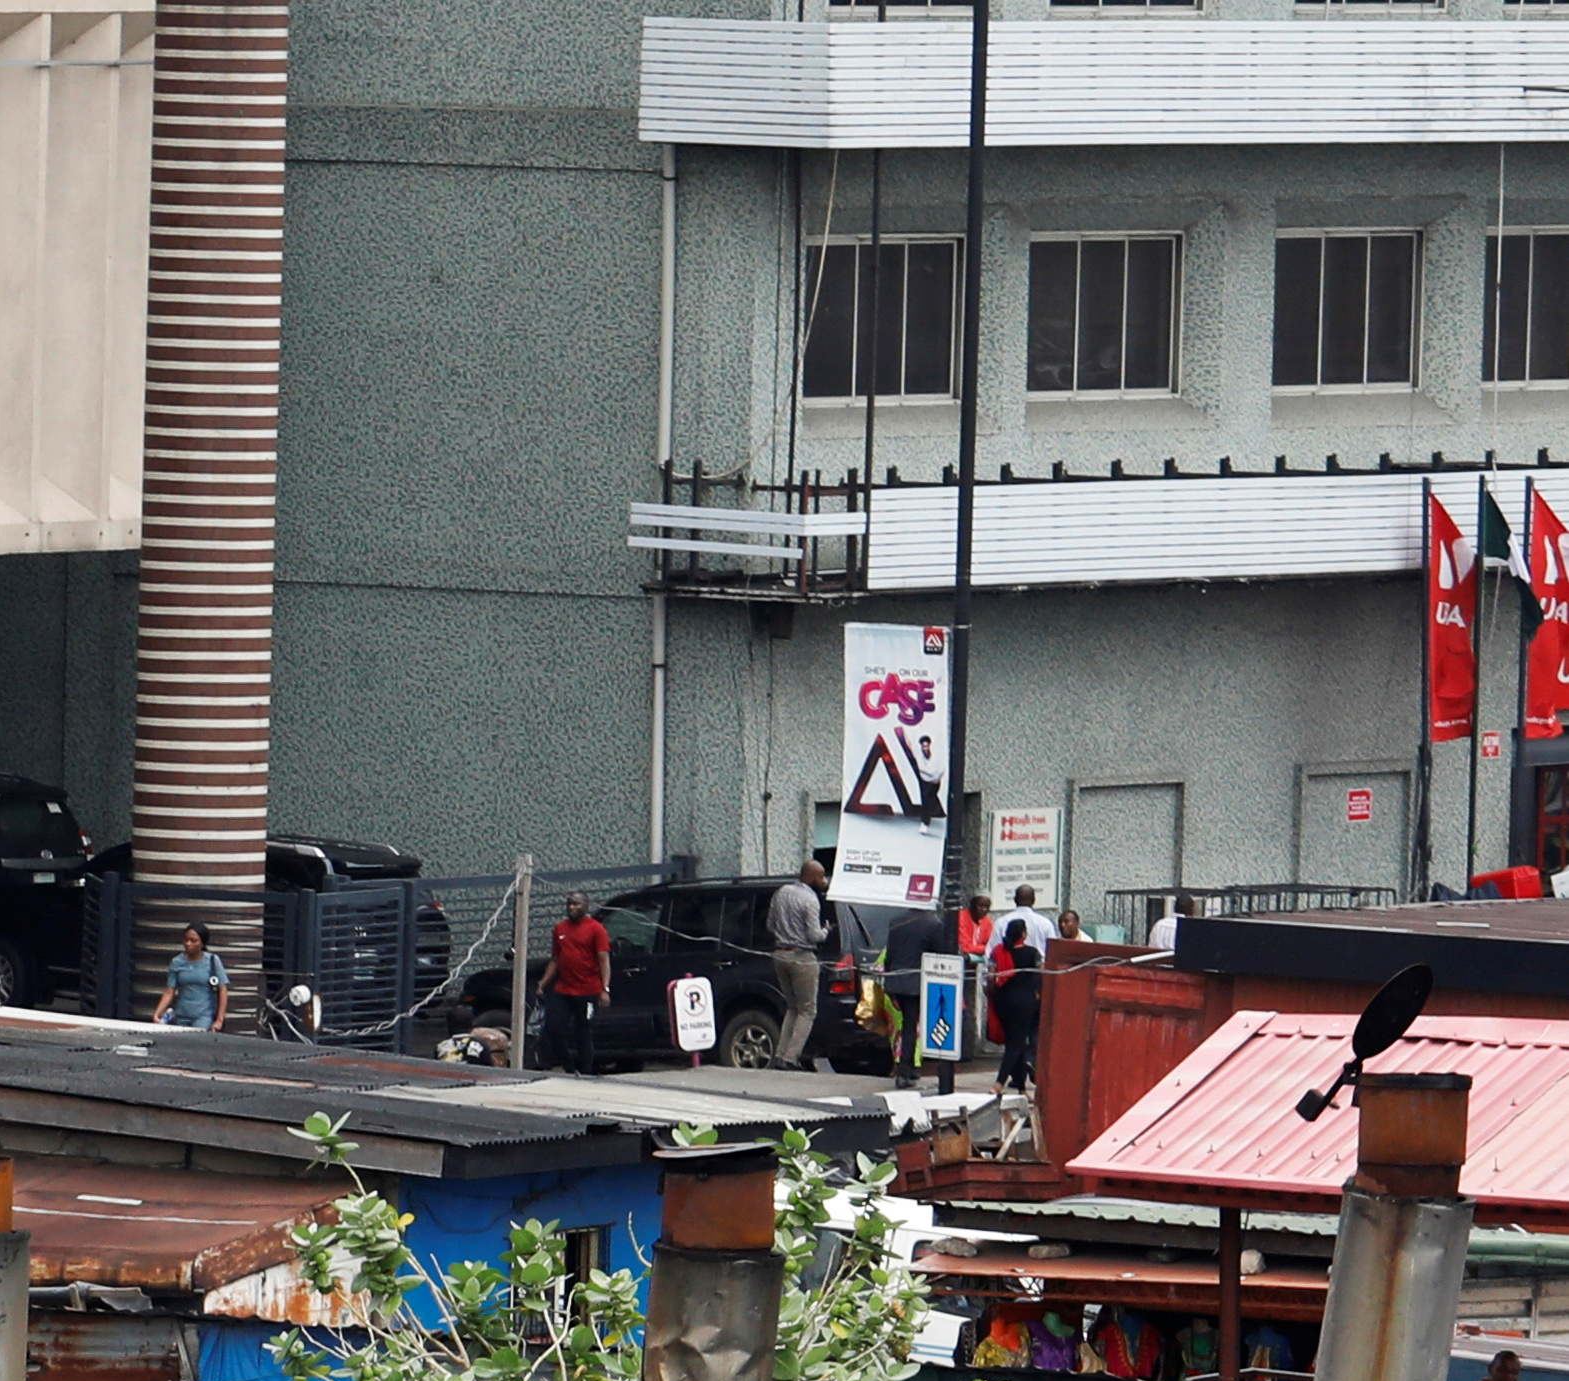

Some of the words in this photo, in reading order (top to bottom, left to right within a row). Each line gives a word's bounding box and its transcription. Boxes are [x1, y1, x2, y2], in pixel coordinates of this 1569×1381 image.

[864, 666, 886, 675] SHE'S
[899, 668, 912, 676] ON
[912, 669, 928, 678] OUR
[859, 672, 936, 726] CASE
[680, 1021, 689, 1030] NO
